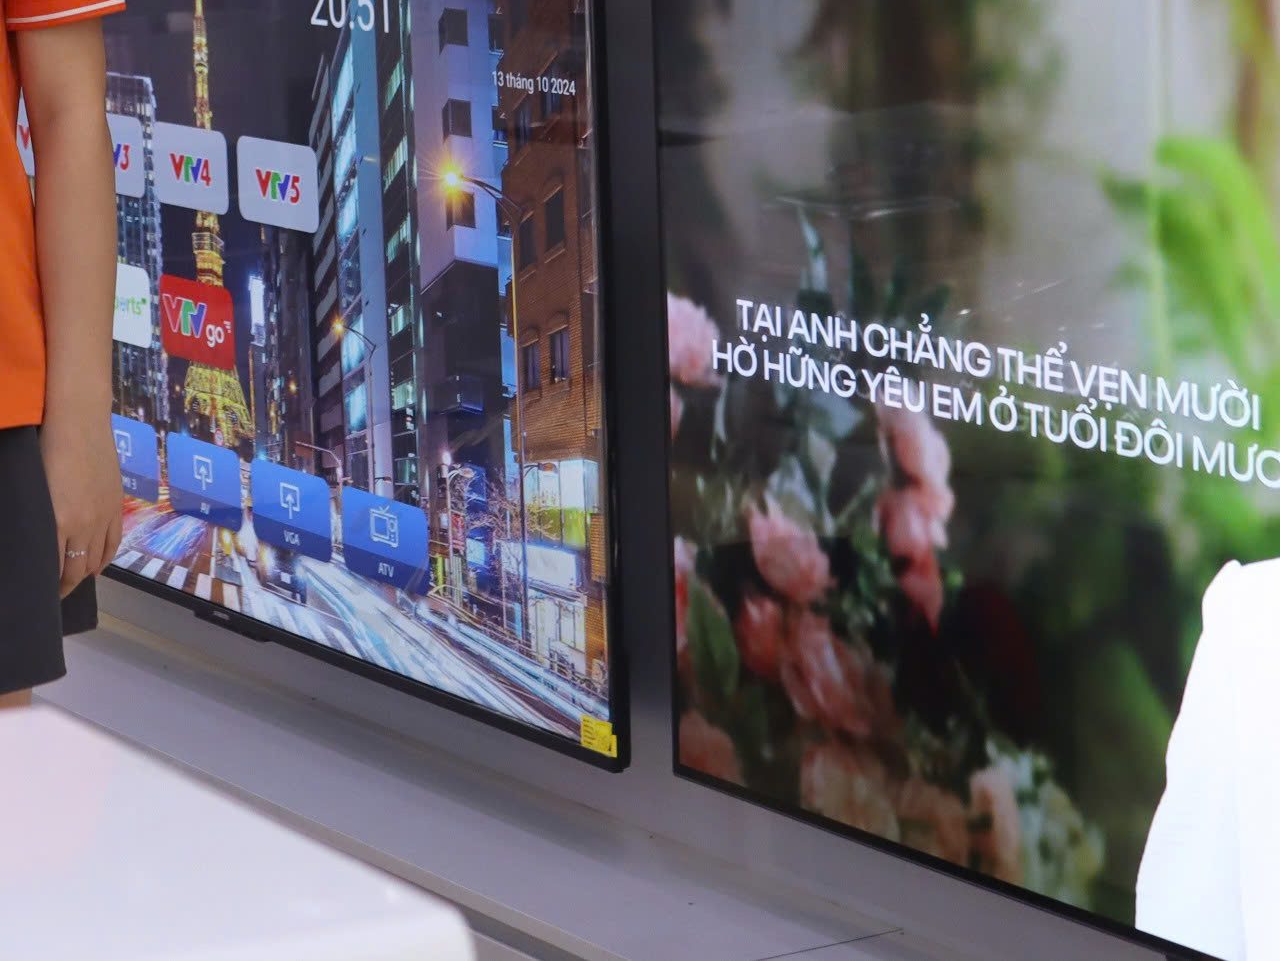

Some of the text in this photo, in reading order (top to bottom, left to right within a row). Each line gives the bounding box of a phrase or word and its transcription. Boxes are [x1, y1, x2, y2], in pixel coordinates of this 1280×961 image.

[492, 71, 576, 97] 13 tháng 10 2024
[169, 152, 212, 187] VTV4
[256, 168, 300, 204] VTV5
[205, 323, 225, 348] go
[736, 299, 1260, 431] TẠI ANH CHẲNG THỂ VẸN MƯỜI
[712, 336, 758, 377] HỜ
[764, 347, 857, 399] HỮNG
[861, 366, 925, 413] YÊU
[932, 383, 982, 426] EM
[989, 385, 1019, 432] Ở
[1023, 397, 1107, 453] TUỔI
[1114, 418, 1183, 469] ĐÔI
[378, 562, 395, 578] ATV
